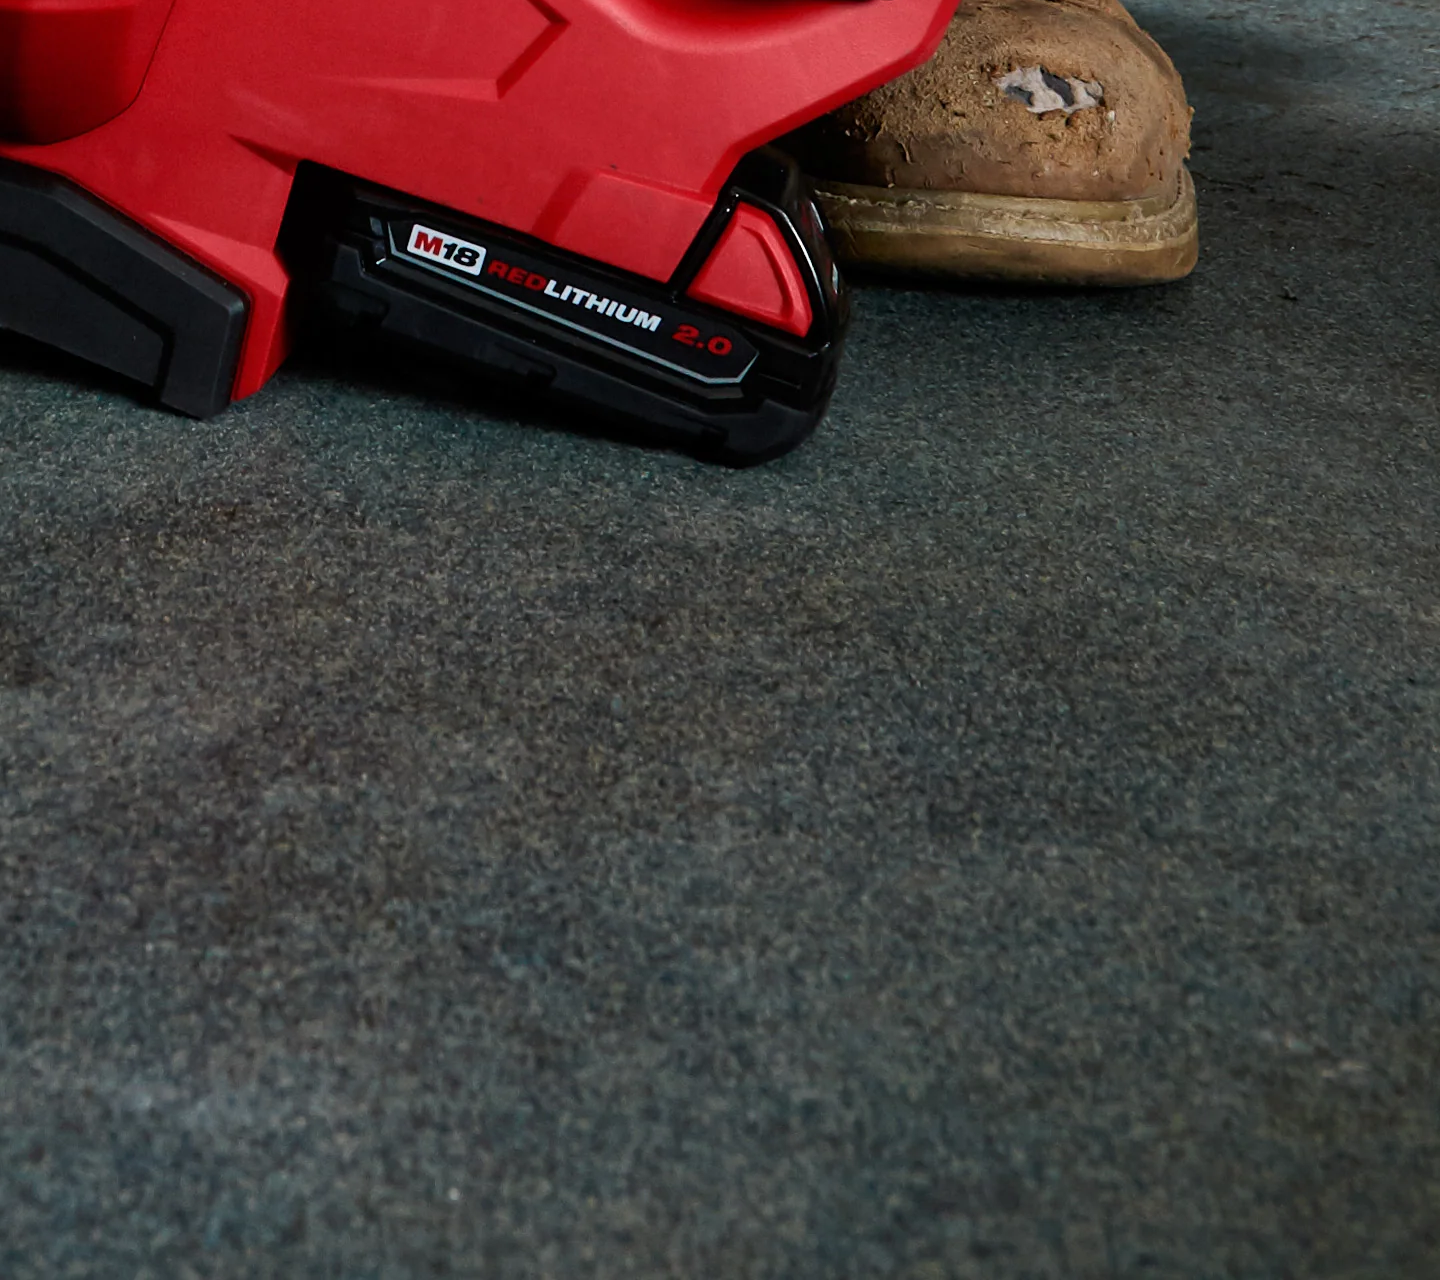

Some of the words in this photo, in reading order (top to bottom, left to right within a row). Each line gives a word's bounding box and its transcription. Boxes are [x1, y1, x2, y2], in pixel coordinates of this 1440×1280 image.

[413, 230, 481, 268] M18
[487, 259, 662, 332] REDLITHIUM
[671, 324, 732, 356] 2.0
